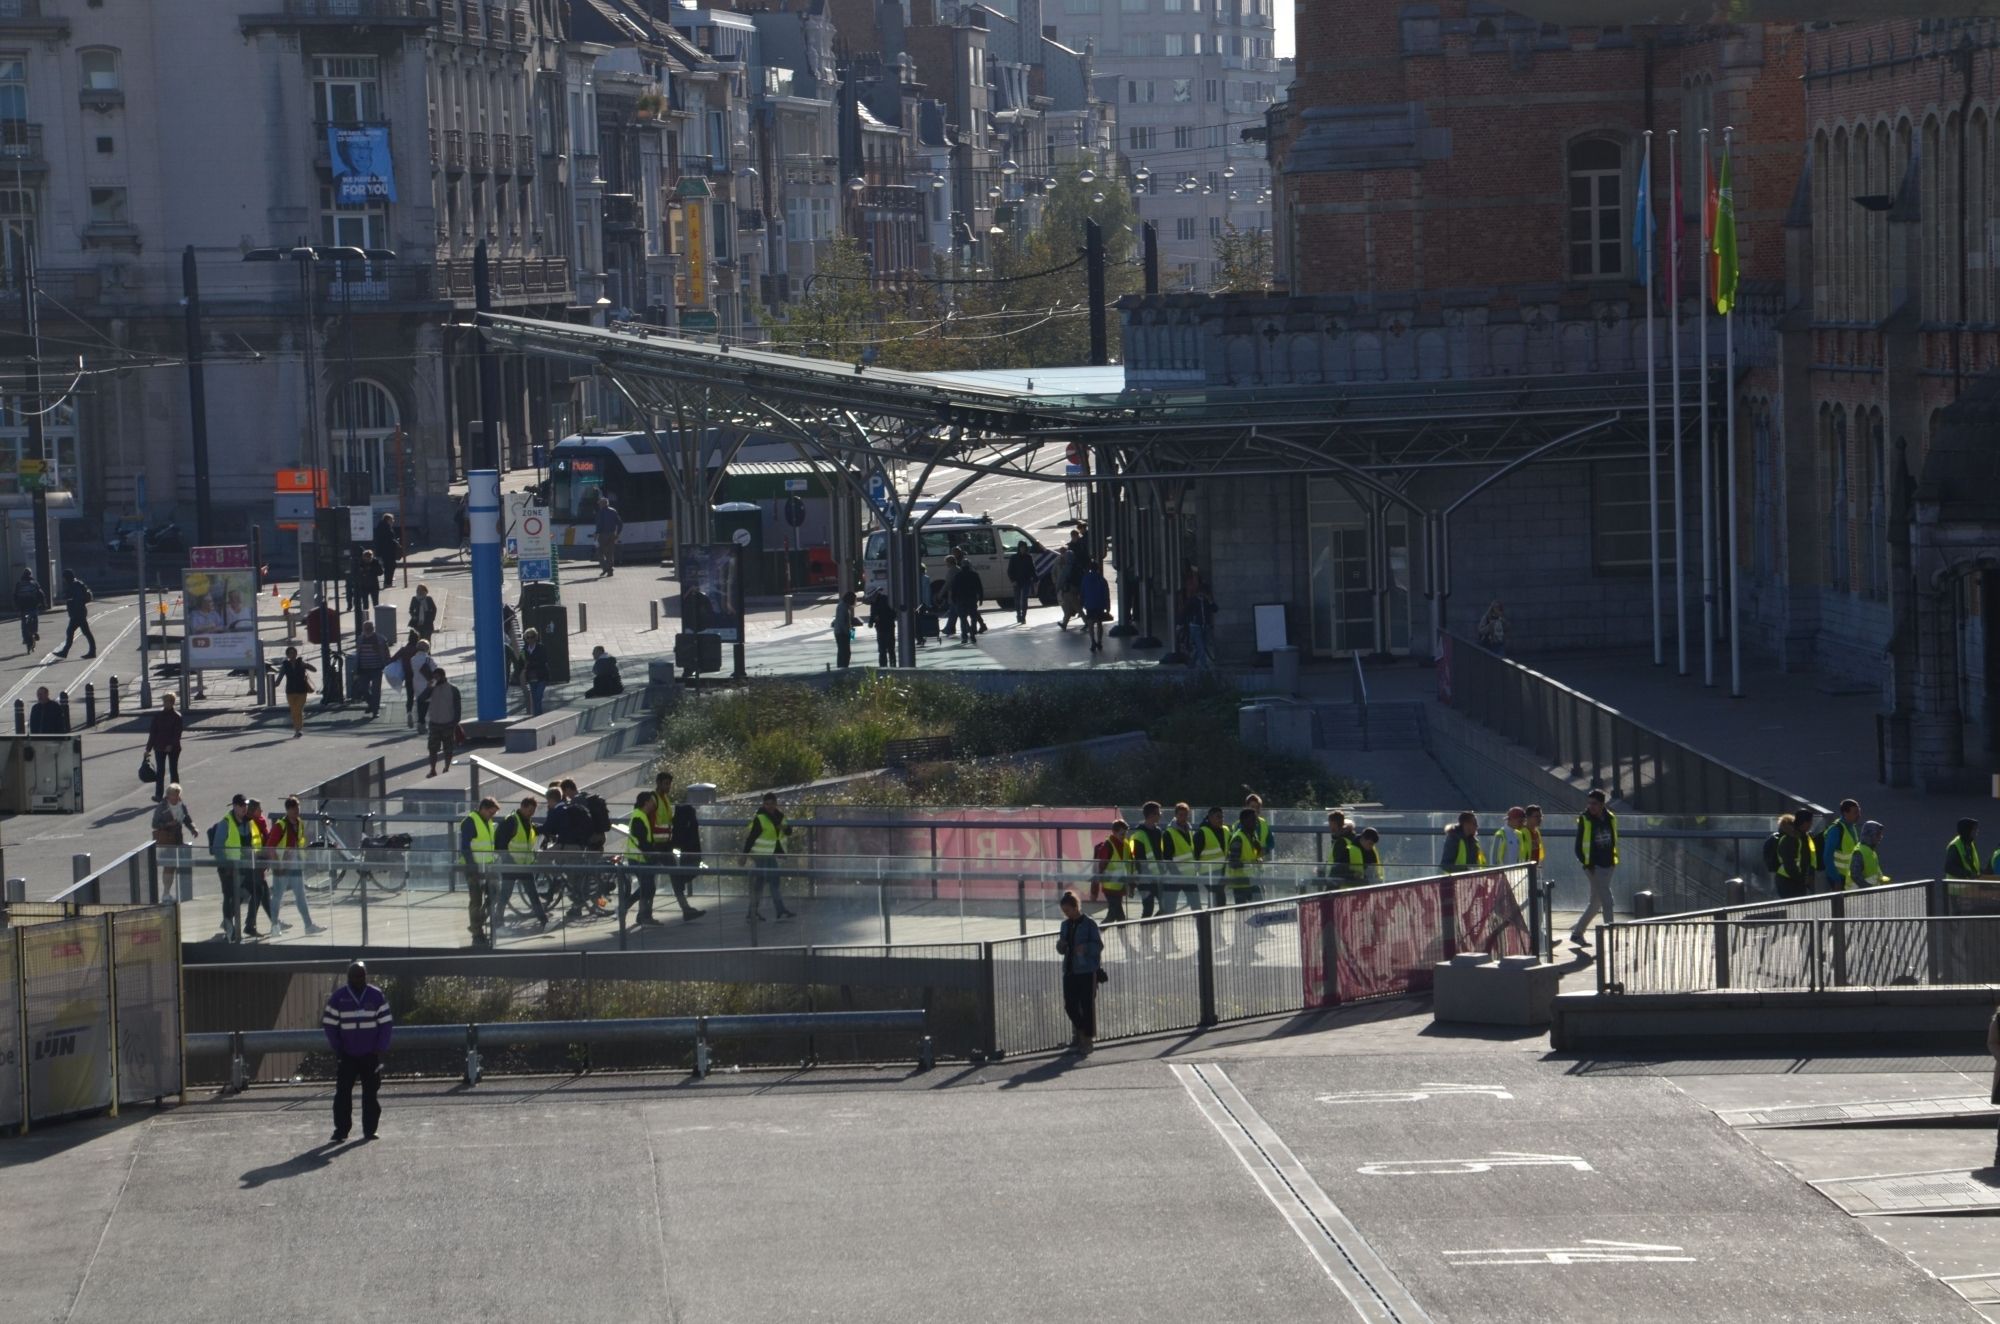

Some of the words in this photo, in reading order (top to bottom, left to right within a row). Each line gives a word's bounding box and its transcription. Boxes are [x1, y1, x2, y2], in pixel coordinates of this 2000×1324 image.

[342, 184, 366, 196] FOR
[368, 184, 388, 195] YOU
[558, 461, 565, 470] 4
[869, 476, 882, 495] P
